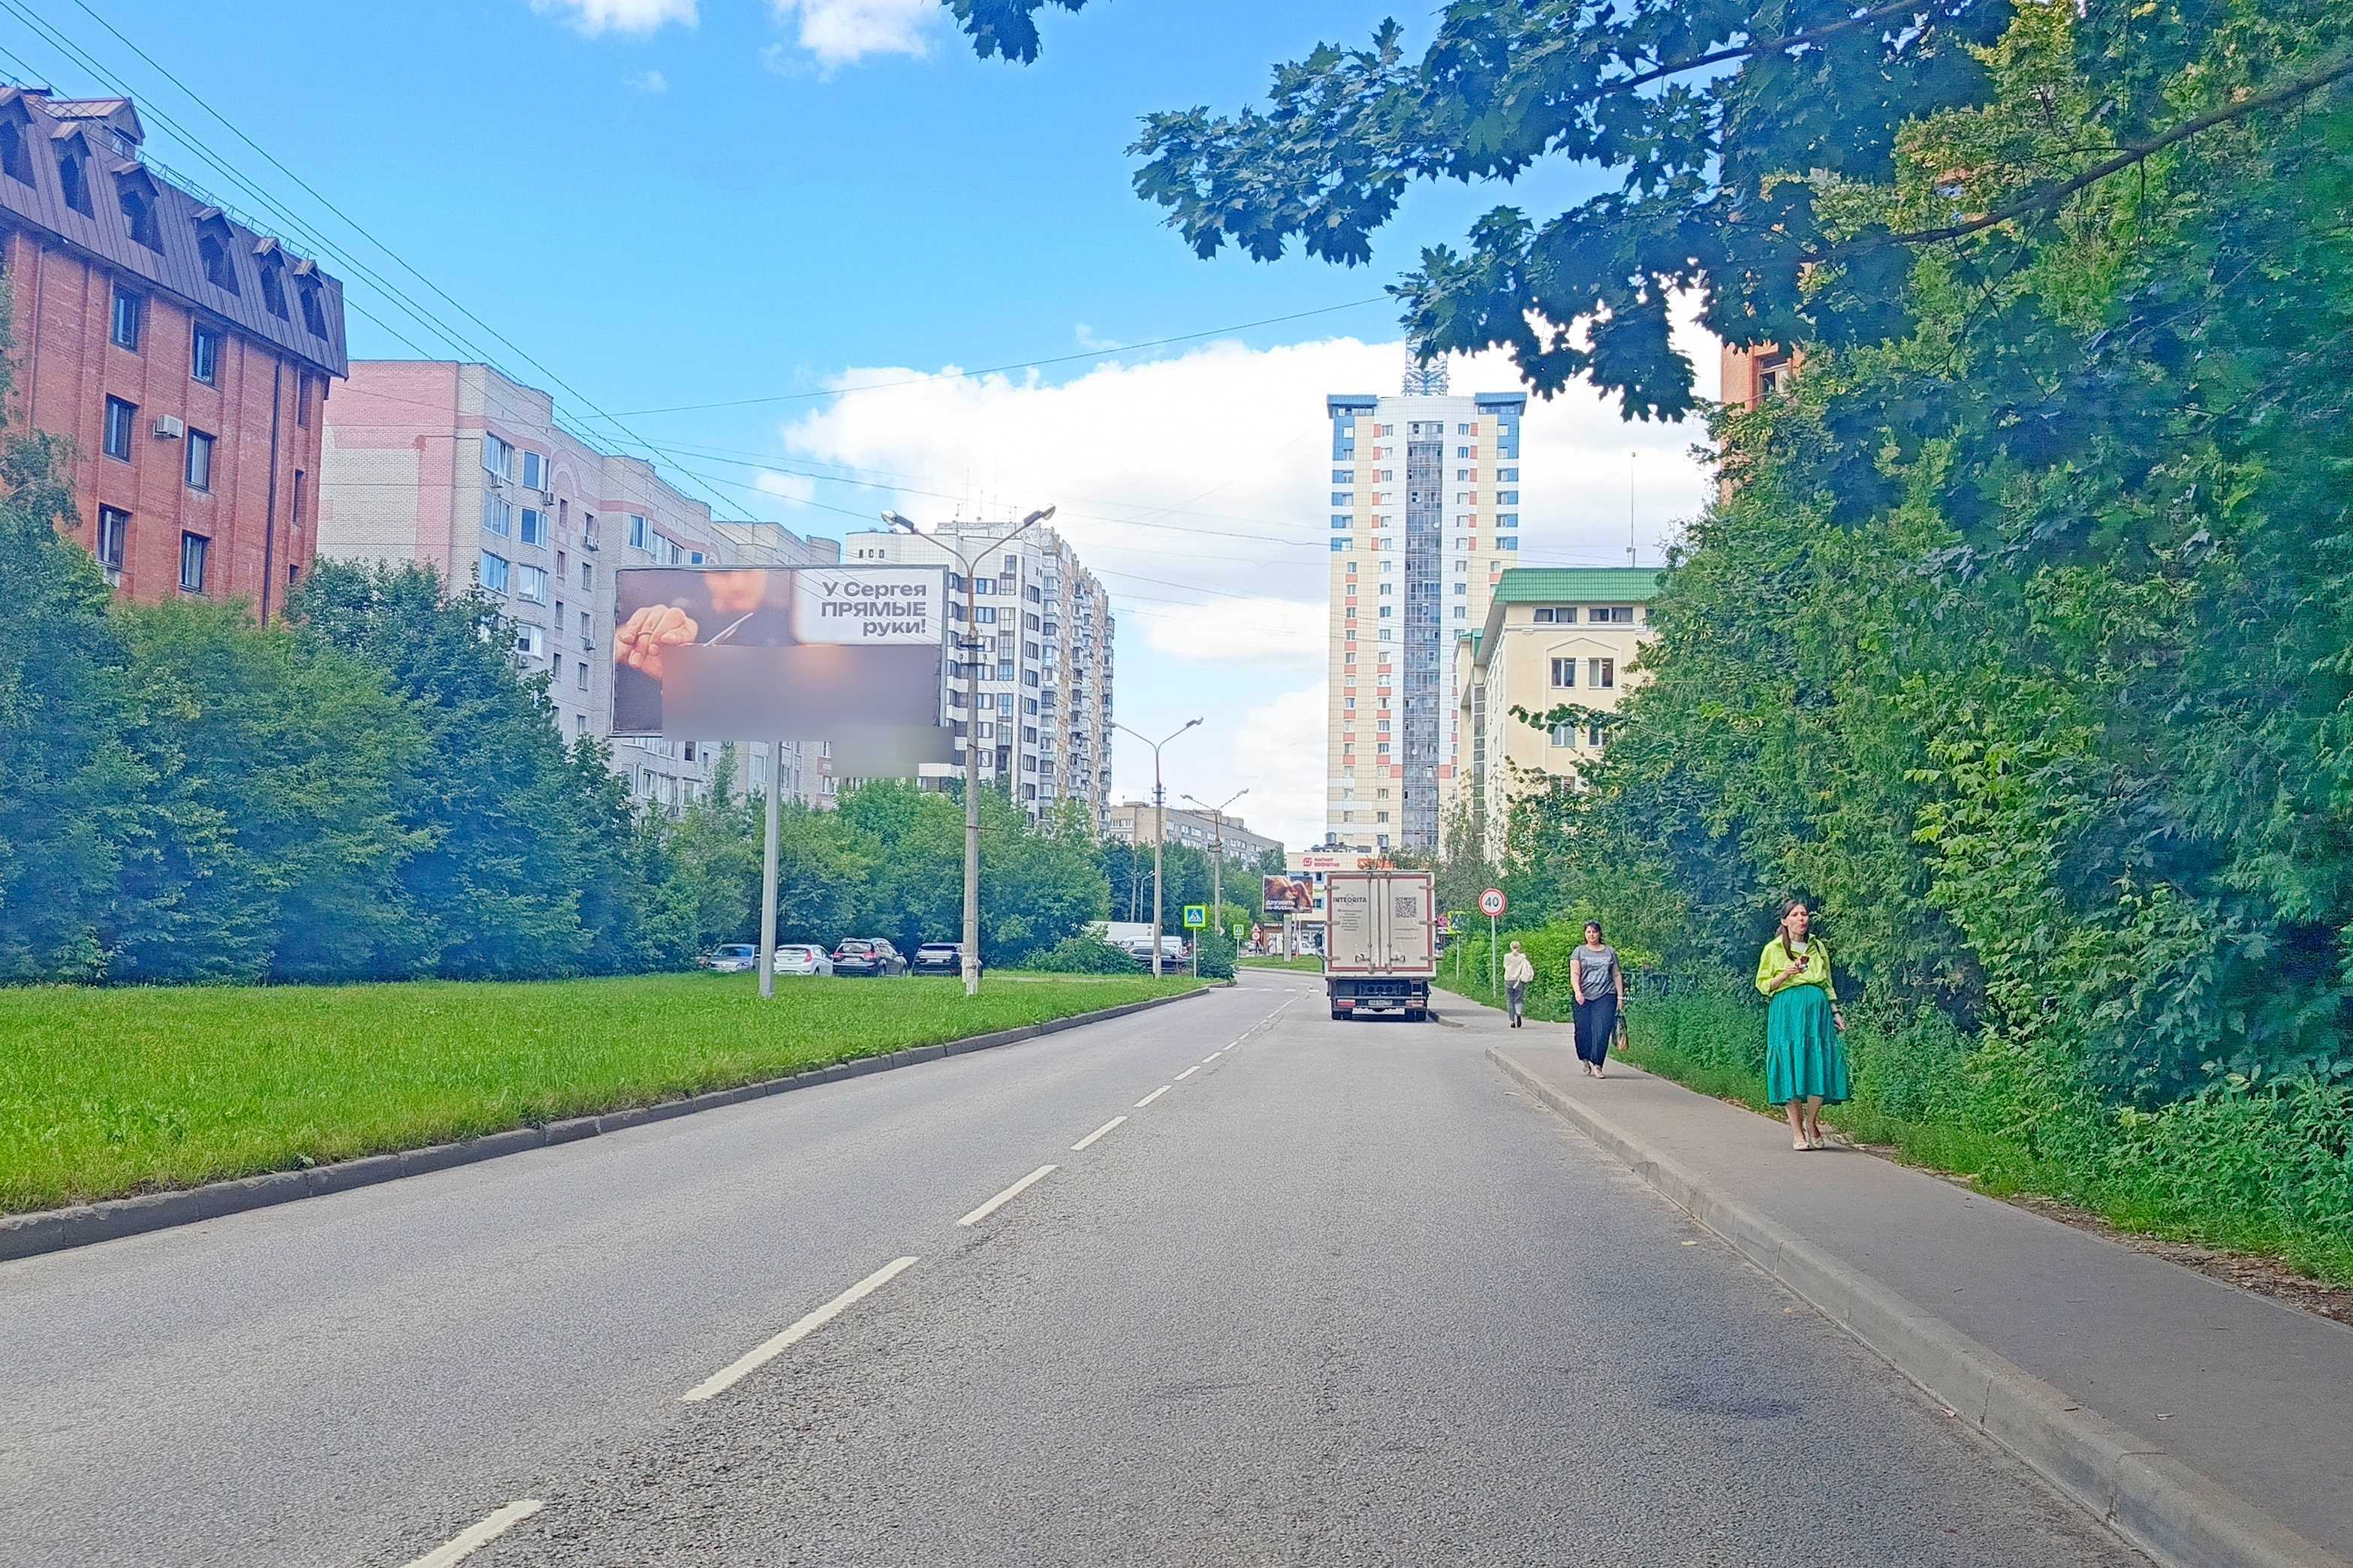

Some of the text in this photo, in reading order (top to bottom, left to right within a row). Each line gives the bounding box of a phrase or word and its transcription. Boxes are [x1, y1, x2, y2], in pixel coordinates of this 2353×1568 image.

[823, 581, 926, 600] У Сергея
[821, 601, 926, 617] ПРЯМЫЕ
[863, 618, 926, 637] руки!
[1484, 896, 1499, 907] 40
